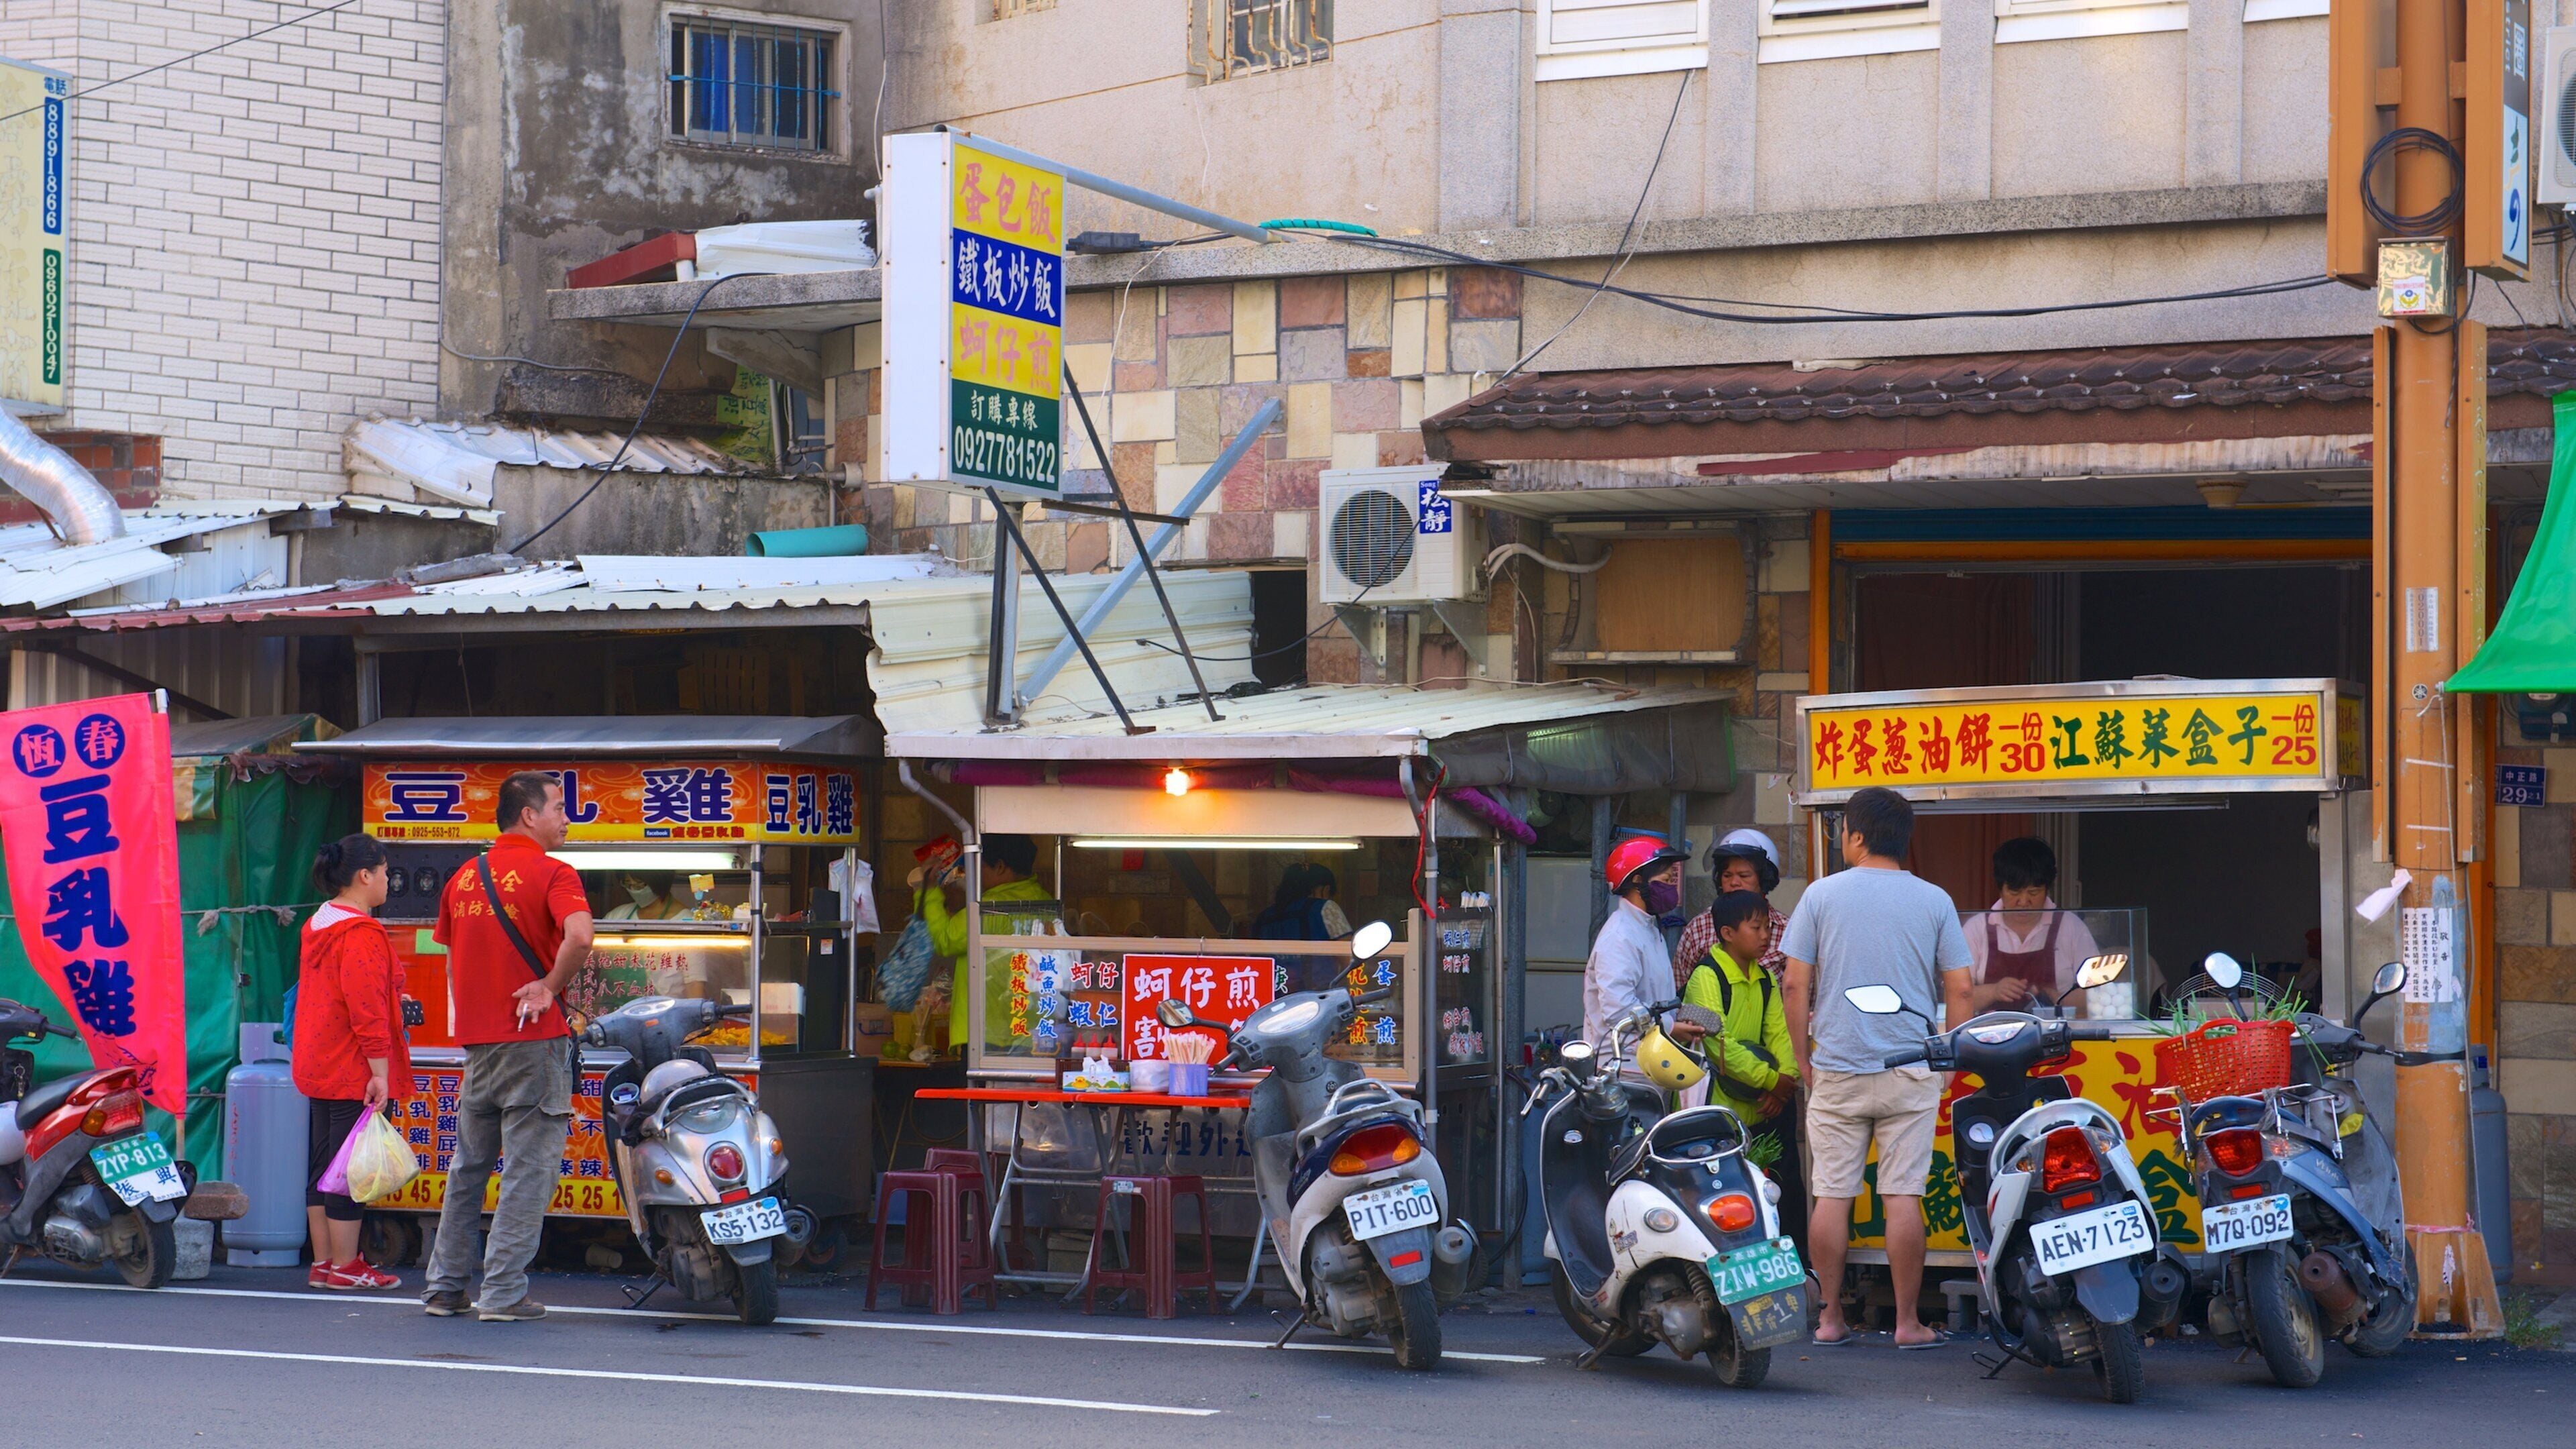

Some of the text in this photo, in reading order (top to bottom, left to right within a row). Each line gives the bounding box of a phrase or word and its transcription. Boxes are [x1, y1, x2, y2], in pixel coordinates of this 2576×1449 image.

[44, 76, 67, 96] 電話
[46, 104, 58, 229] 8891866
[959, 162, 1057, 246] 蛋包飯
[957, 236, 1057, 319] 鐵板炒飯
[46, 254, 57, 380] 0960210047
[959, 315, 1053, 394] 蚵仔煎
[970, 389, 1038, 431] 訂購專線
[955, 425, 1056, 485] 0927781522
[1998, 712, 2043, 742] 一份
[2049, 705, 2267, 770] 江蘇菜盒子
[2271, 703, 2315, 735] 一份
[20, 720, 119, 774] 恆春
[2000, 743, 2045, 773] 30
[2271, 735, 2317, 765] 25
[2506, 771, 2537, 783] 中正路
[765, 773, 854, 837] 豆乳雞
[40, 773, 137, 1038] 豆乳雞
[1010, 953, 1031, 1037] 鐵板炒飯
[1036, 954, 1059, 1038] 鹹魚炒飯
[1068, 1000, 1118, 1028] 蝦仁
[1134, 965, 1260, 1010] 蚵仔煎
[580, 1079, 604, 1177] 甜不辣
[411, 1179, 431, 1203] 45
[553, 1185, 574, 1212] 25
[582, 1185, 604, 1210] 25
